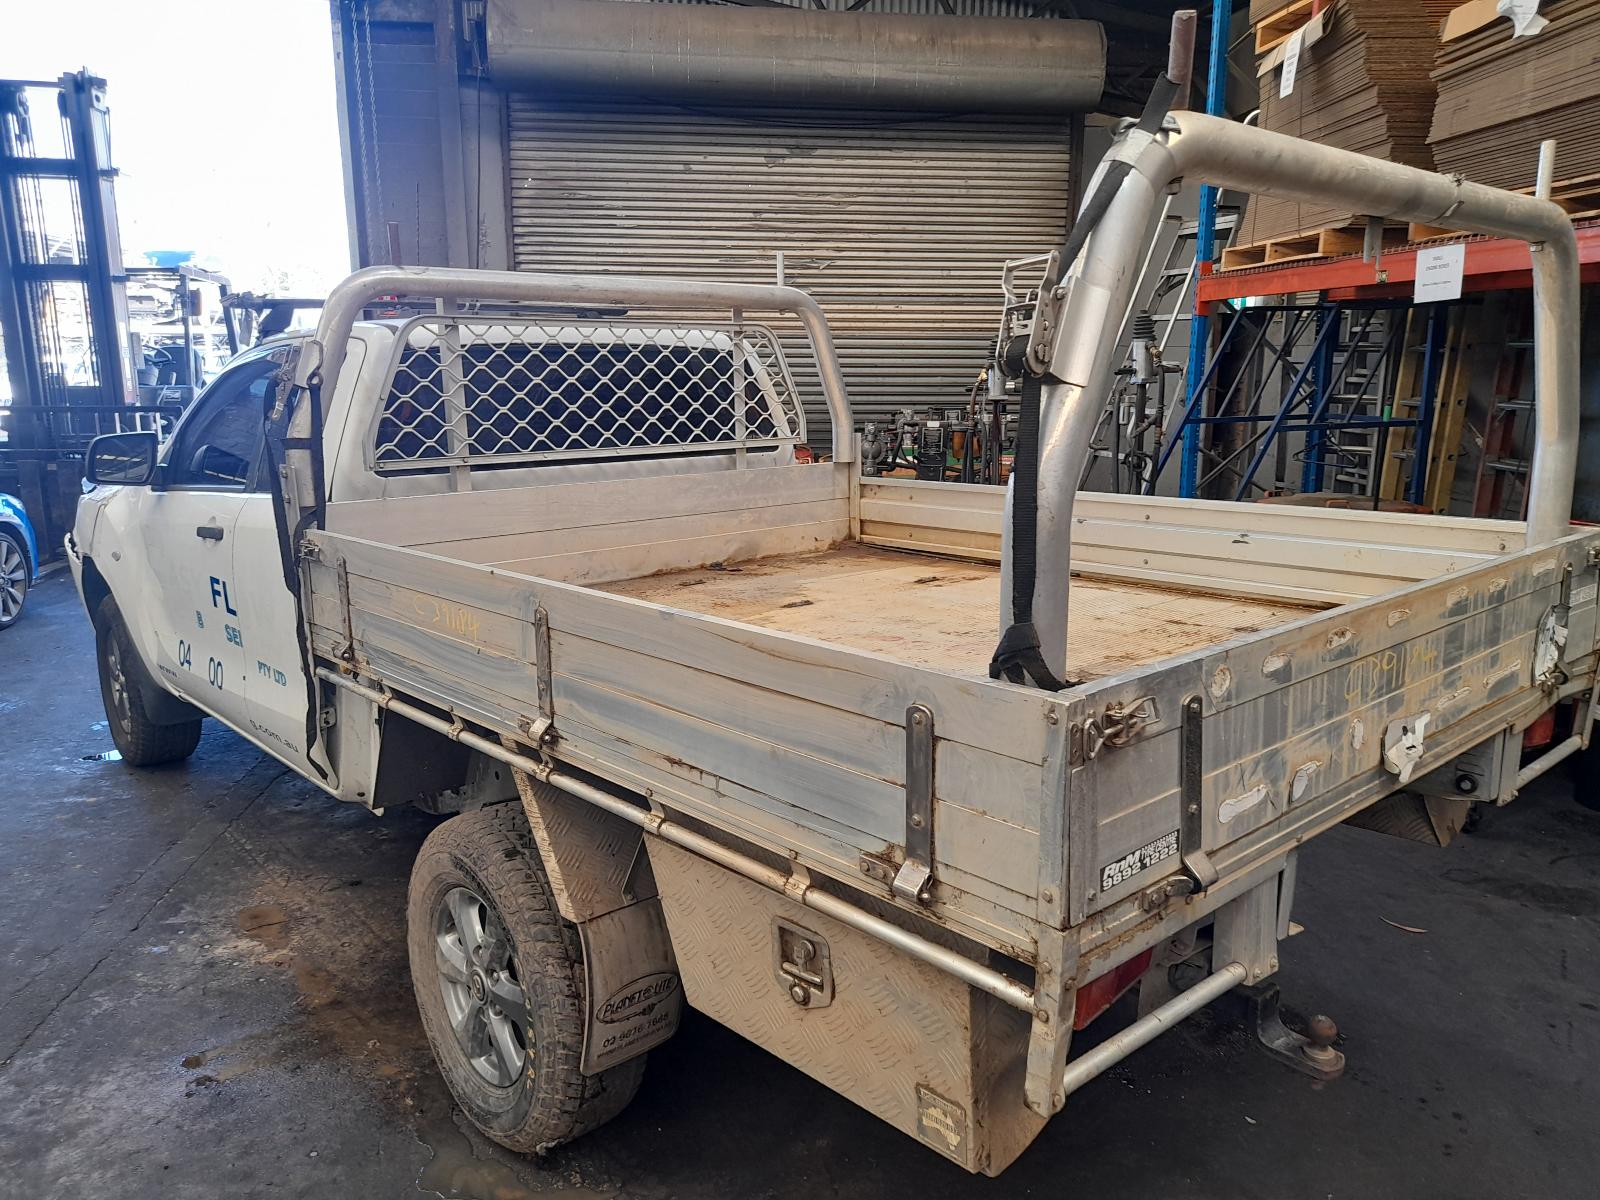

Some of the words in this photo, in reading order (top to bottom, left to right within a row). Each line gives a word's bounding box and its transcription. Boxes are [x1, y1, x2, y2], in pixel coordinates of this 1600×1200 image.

[209, 575, 238, 617] FL
[178, 639, 192, 671] 04
[208, 656, 223, 690] 00
[257, 660, 271, 679] PTY
[273, 668, 287, 687] LTD
[1102, 862, 1141, 891] 9892
[1143, 843, 1178, 867] 1222
